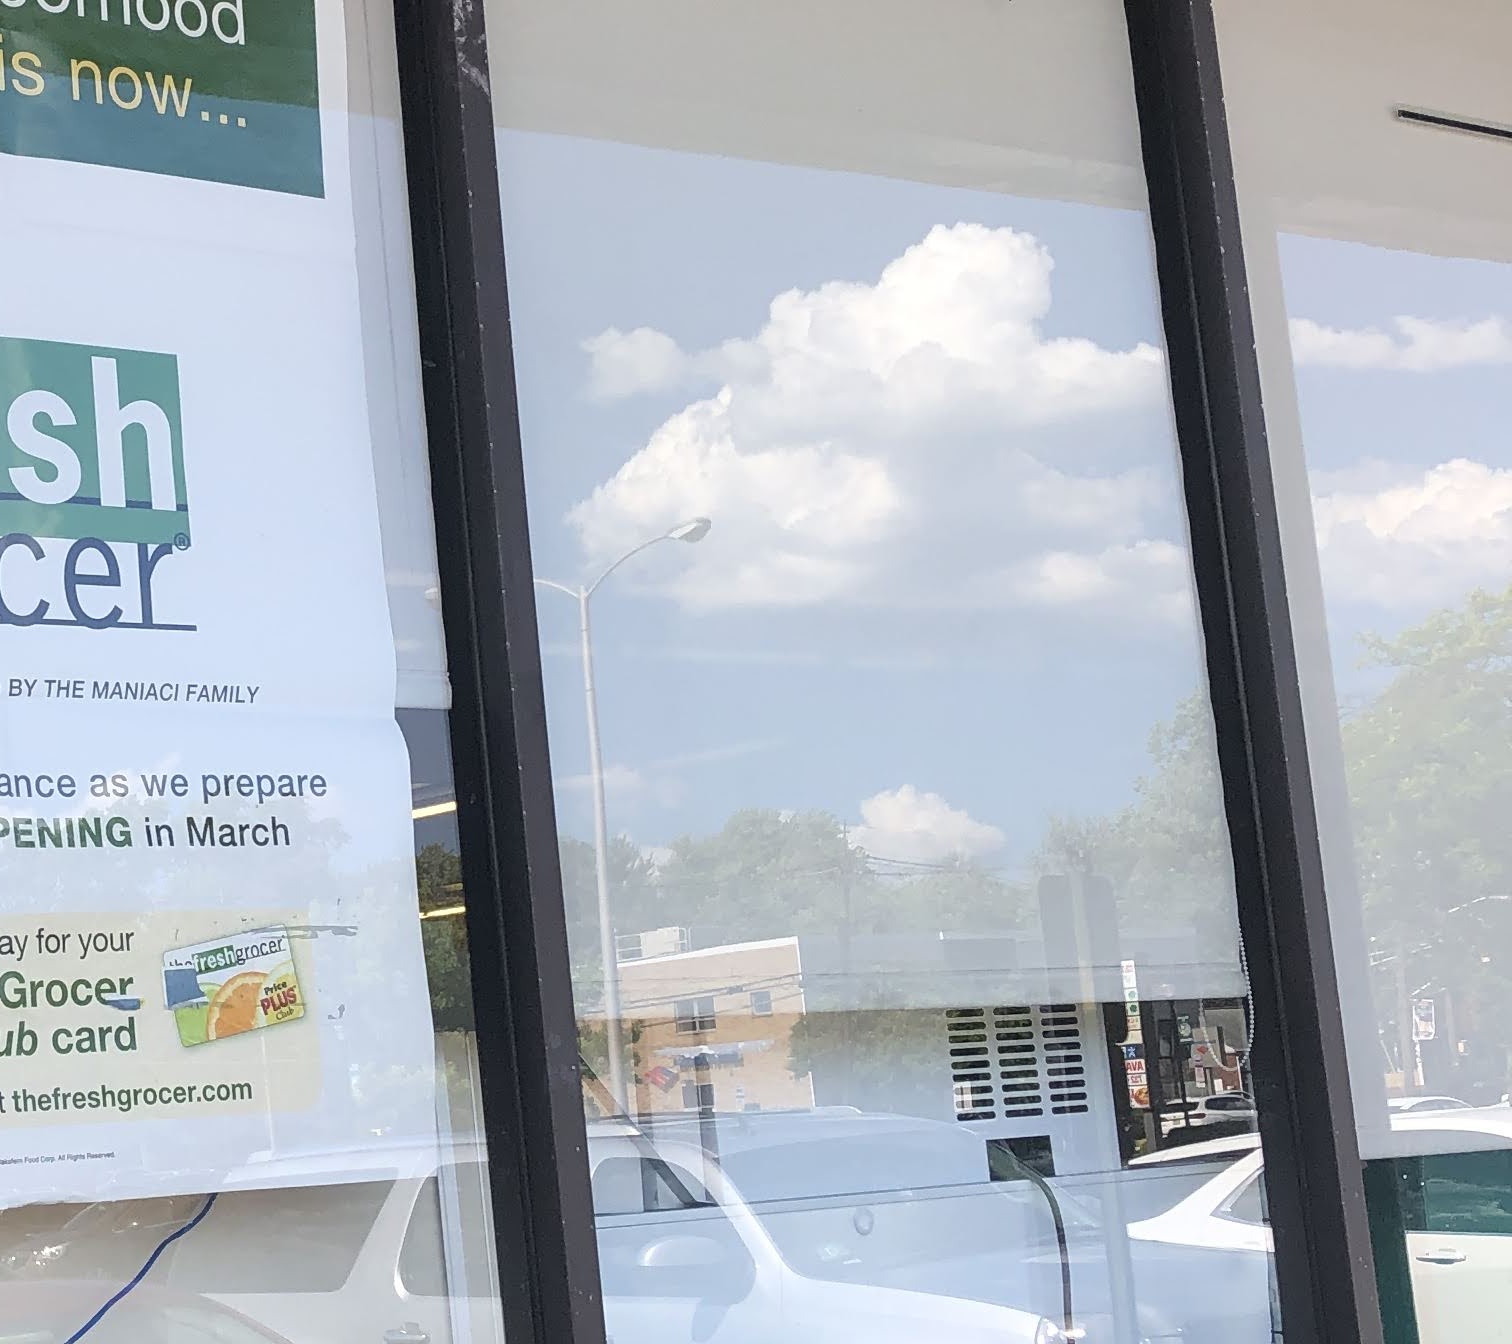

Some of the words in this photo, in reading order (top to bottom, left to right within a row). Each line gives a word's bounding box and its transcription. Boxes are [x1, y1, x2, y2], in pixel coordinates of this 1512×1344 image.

[71, 54, 249, 130] now...
[8, 679, 37, 697] BY
[45, 679, 85, 698] THE
[91, 681, 179, 702] MANIACI
[186, 683, 260, 704] FAMILY
[89, 774, 129, 798] as
[140, 773, 189, 797] we
[201, 773, 328, 804] prepare
[144, 817, 175, 848] in
[186, 816, 291, 848] March
[36, 927, 71, 954] for
[78, 930, 135, 963] your
[263, 981, 288, 996] Price
[52, 1017, 137, 1055] card
[11, 1080, 253, 1113] thefreshgrocer.com
